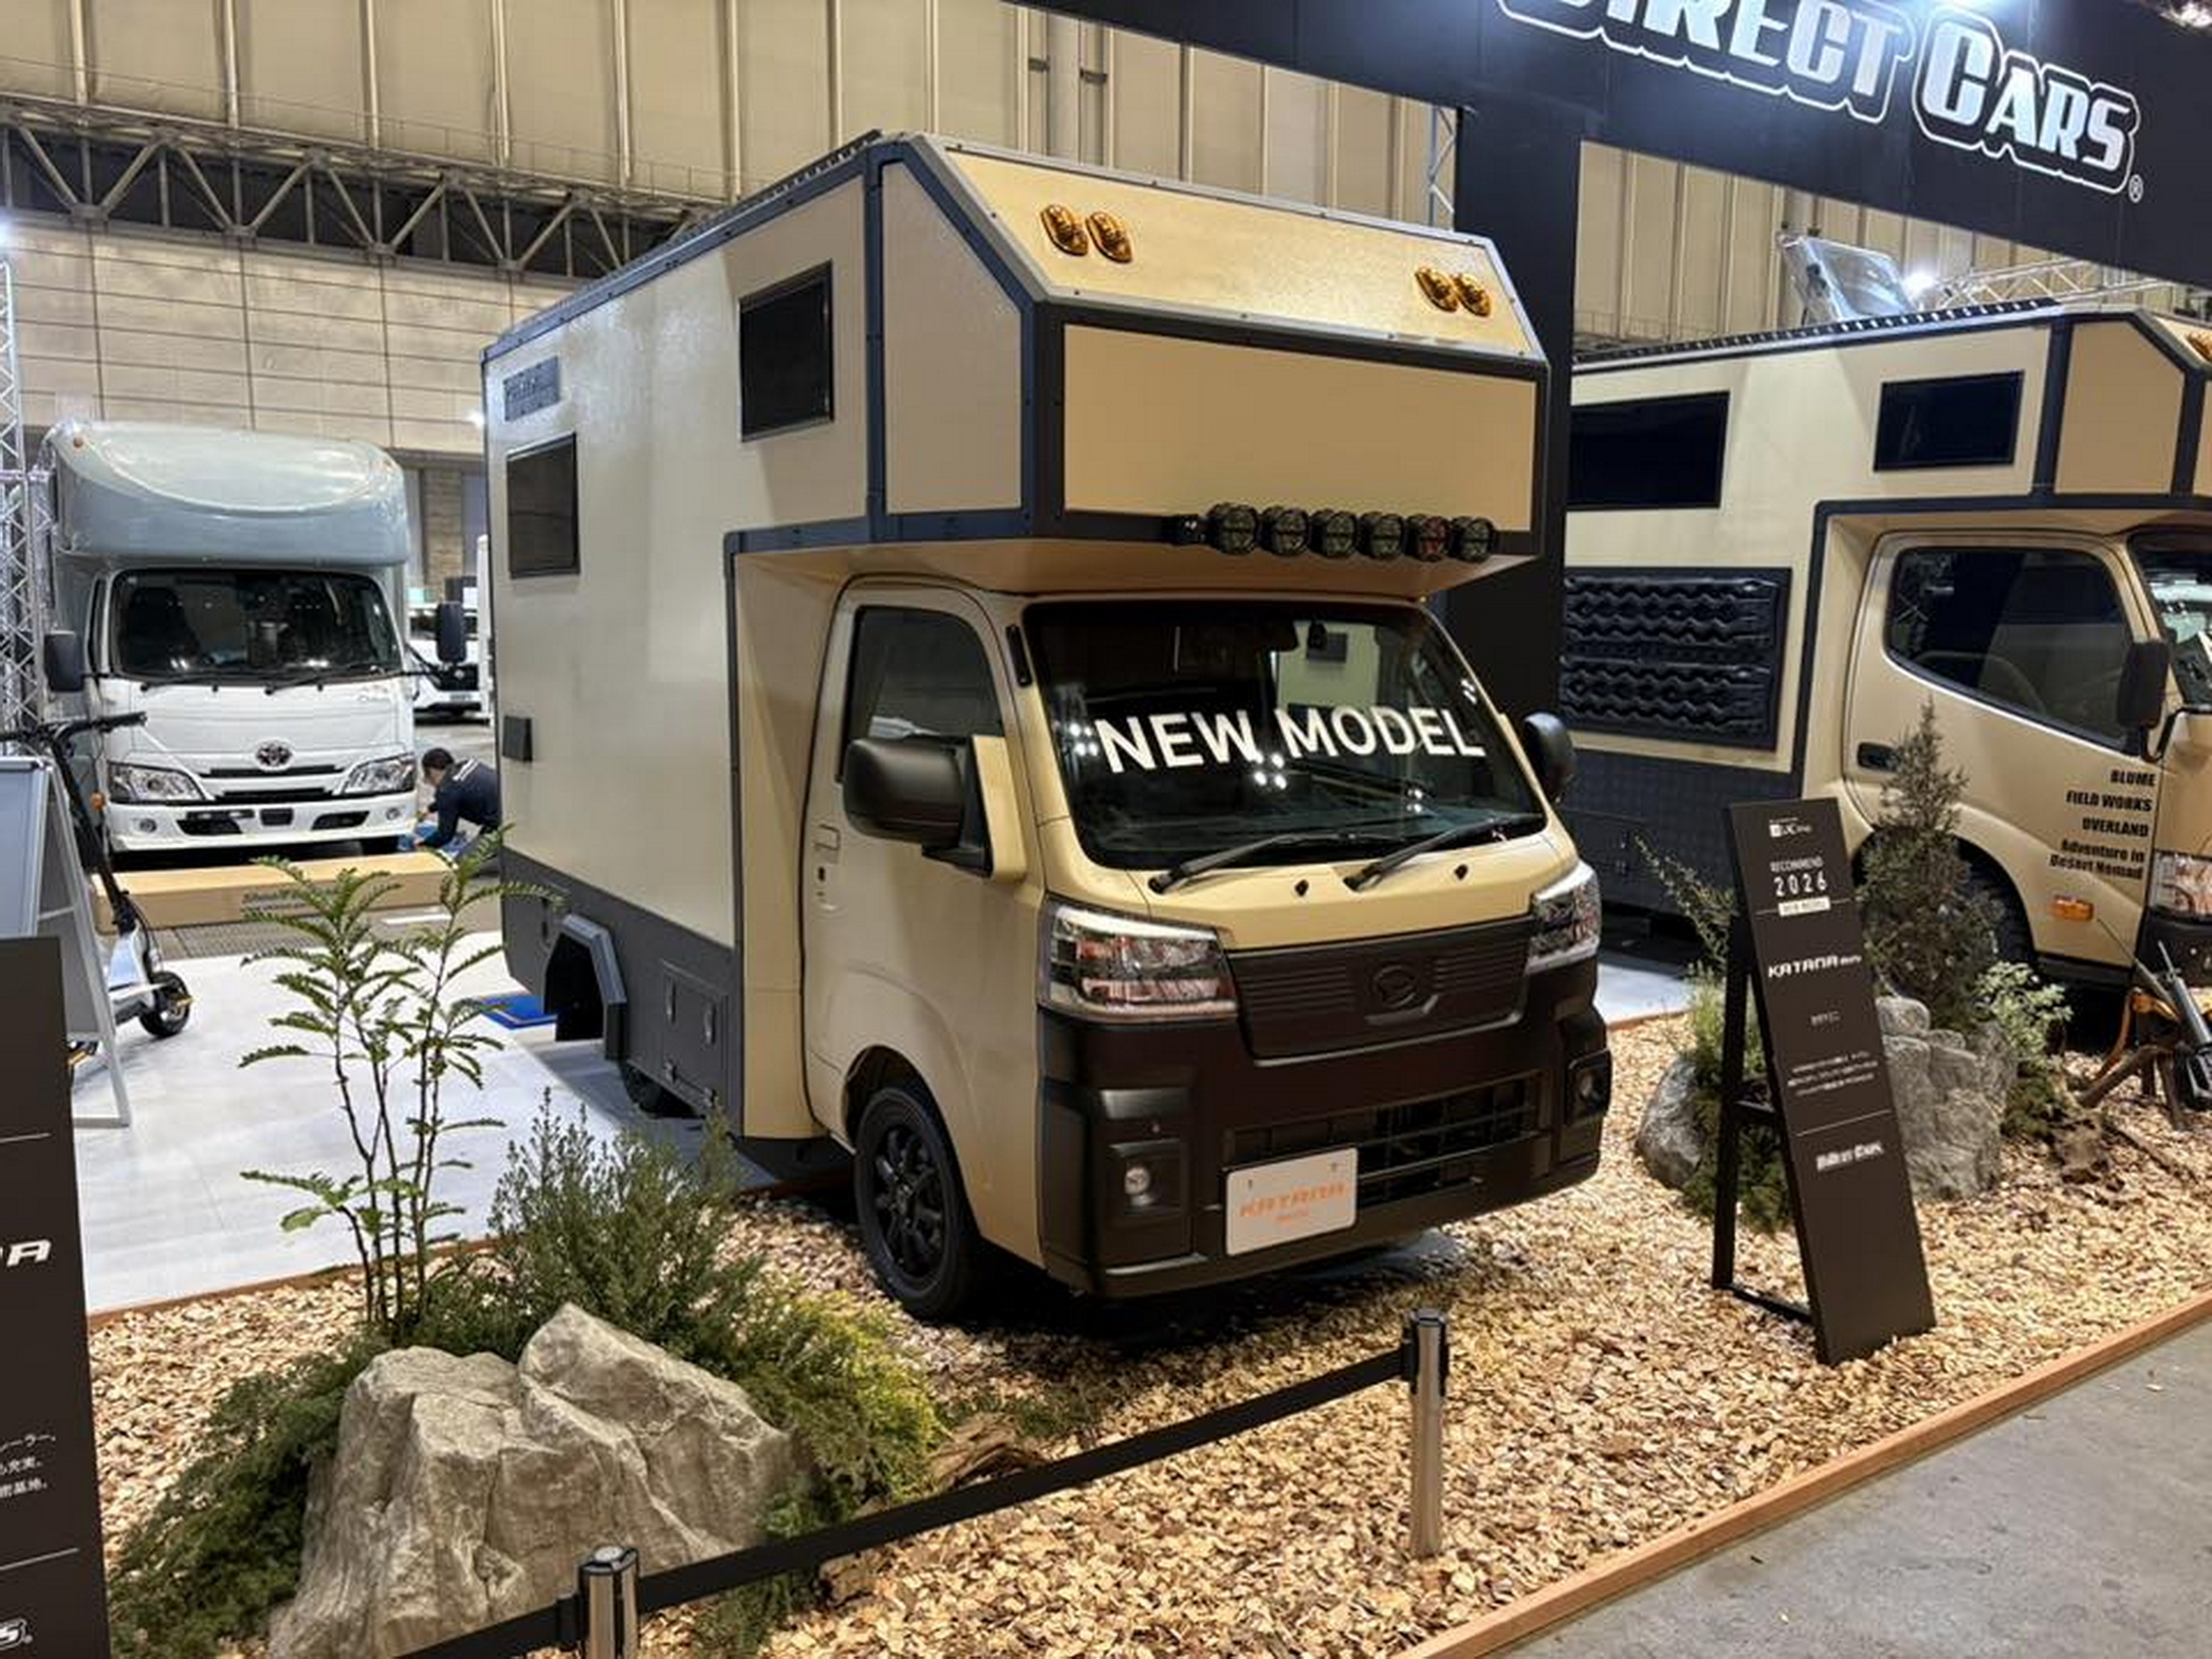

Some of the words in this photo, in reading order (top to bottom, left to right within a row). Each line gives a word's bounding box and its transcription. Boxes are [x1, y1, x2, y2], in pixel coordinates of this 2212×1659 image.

[1921, 22, 2130, 172] CARS
[1094, 710, 1256, 772] NEW
[1274, 705, 1486, 758] MODEL
[2110, 769, 2156, 787] BLUME
[2065, 790, 2100, 806] FIELD
[2101, 794, 2153, 812] WORKS
[2082, 817, 2149, 837] OVERLAND
[2050, 853, 2093, 872] Desert
[2062, 839, 2128, 861] Adventure
[2131, 849, 2145, 863] in
[1773, 870, 1827, 896] 2026
[1769, 955, 1838, 978] KATANA
